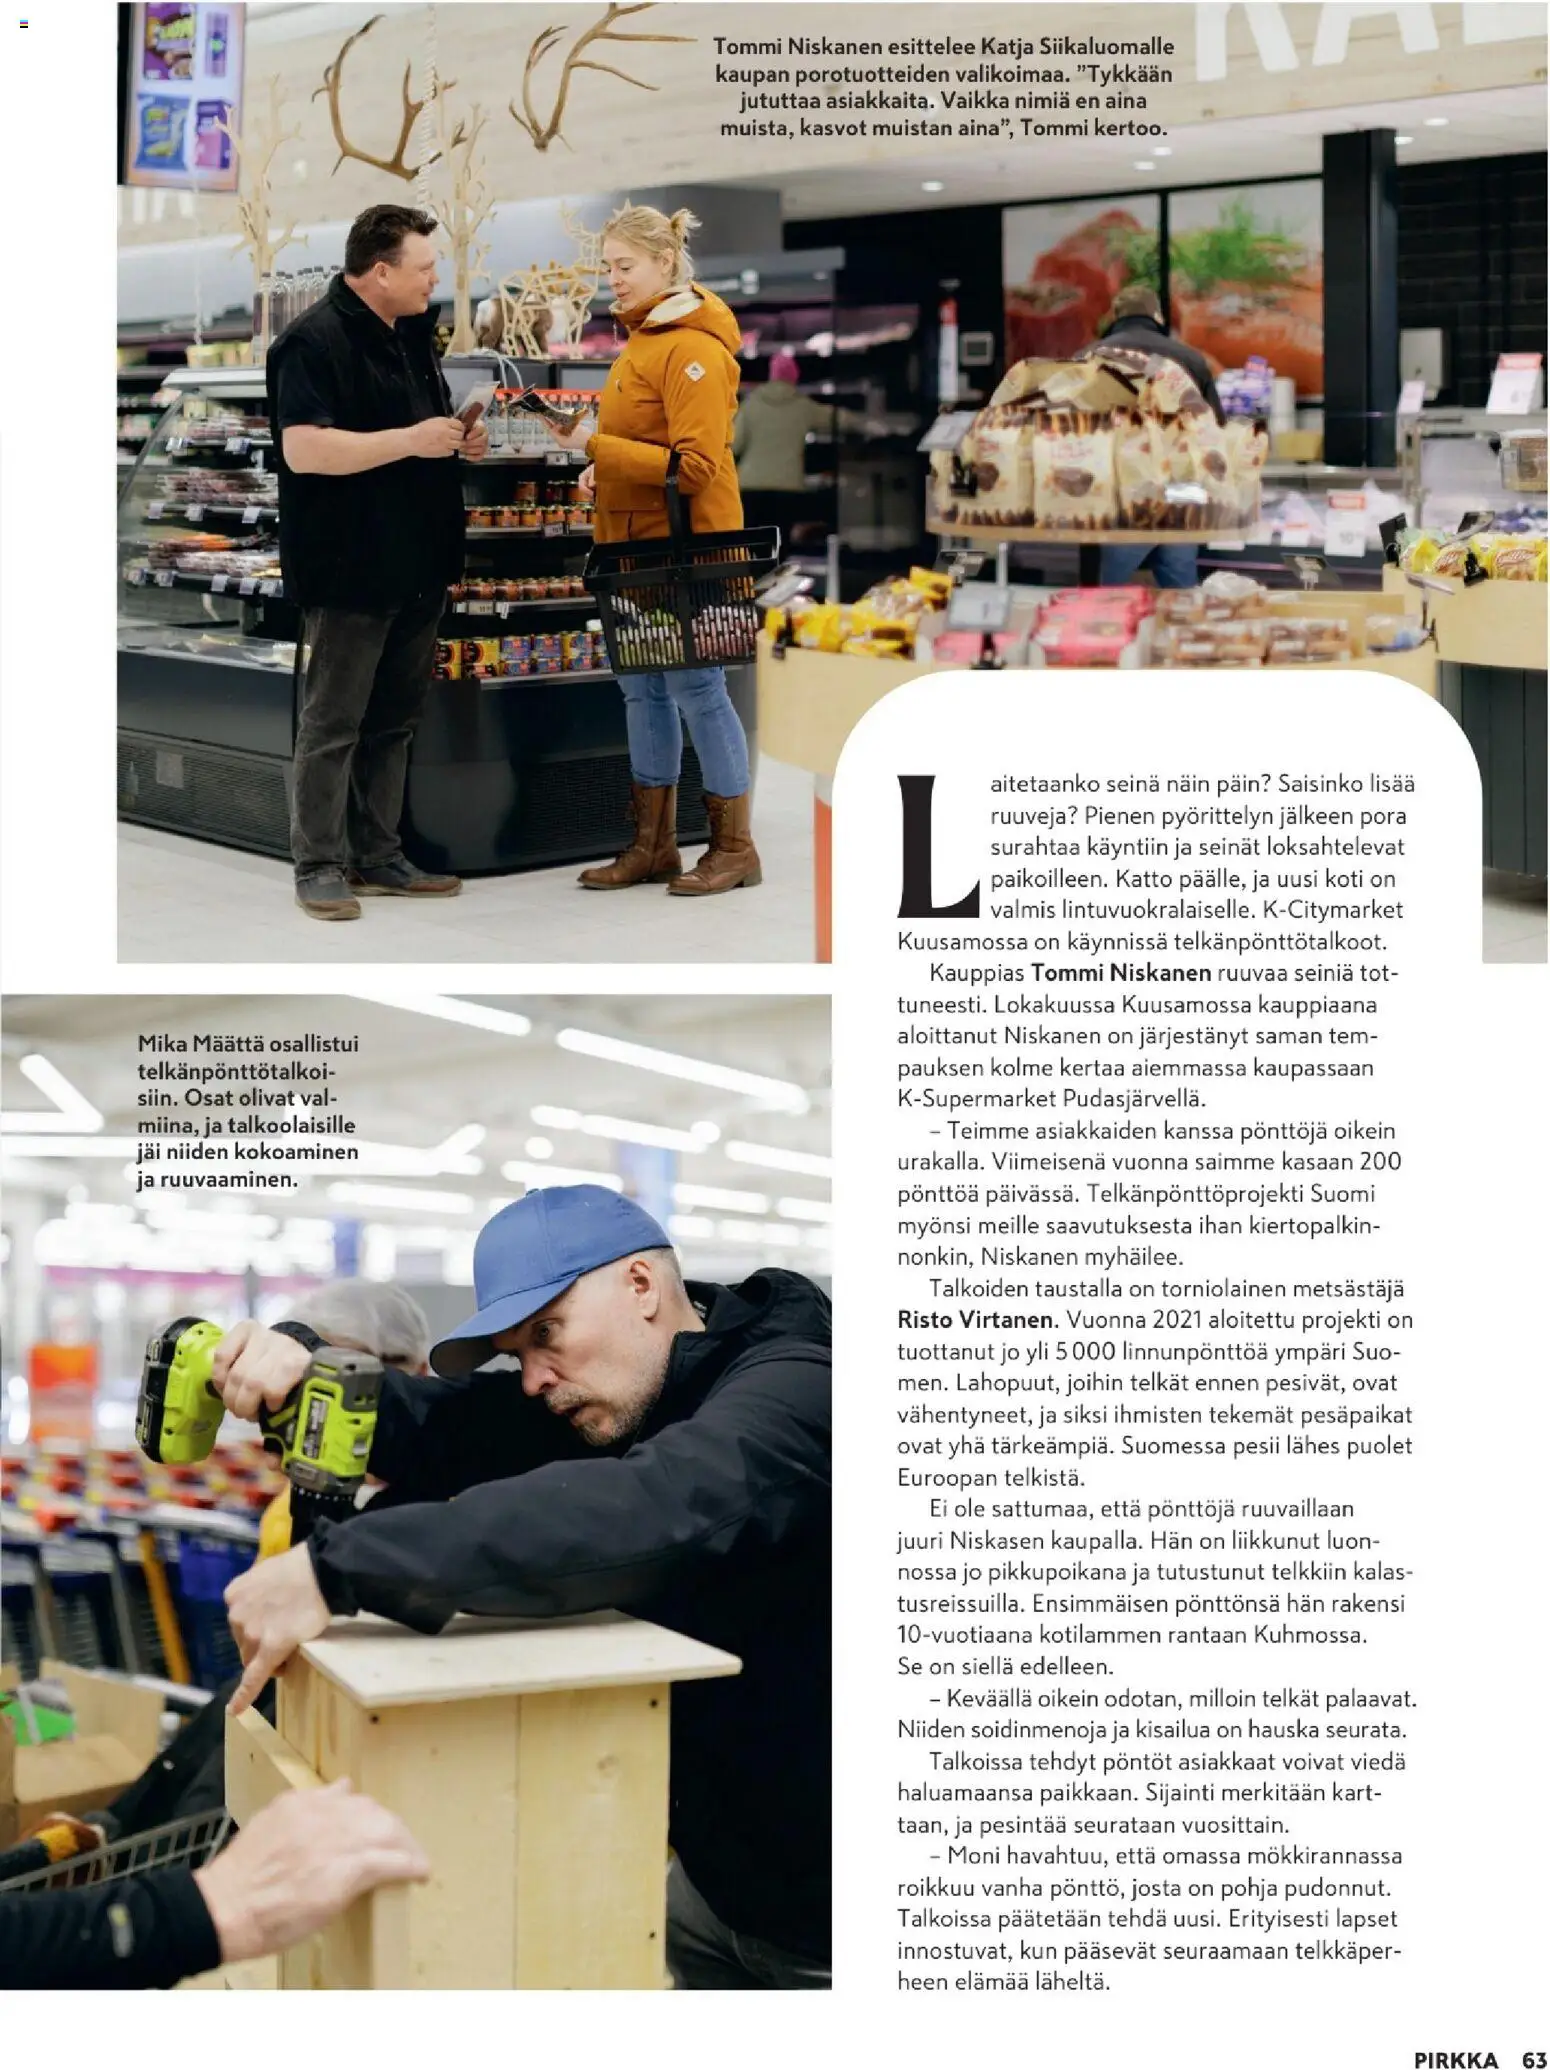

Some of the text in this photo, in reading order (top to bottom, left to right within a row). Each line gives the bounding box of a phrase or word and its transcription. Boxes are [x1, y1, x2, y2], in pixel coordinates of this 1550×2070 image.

[990, 772, 1415, 798] aitetaanko seinä näin päin? Saisinko lisää
[991, 804, 1407, 830] ruuveja? Pienen pyörittelyn jälkeen pora
[897, 775, 981, 918] L
[990, 898, 1404, 924] valmis lintuvuokralaiselle. K-Citymarket
[898, 930, 1387, 956] Kuusamossa on käynnissä telkänpönttötalkoot.
[930, 961, 1399, 987] Kauppias Tommi Niskanen ruuvaa seiniä tot-
[897, 993, 1377, 1019] tuneesti. Lokakuussa Kuusamossa kauppiaana
[897, 1024, 1378, 1050] aloittanut Niskanen on järjestänyt saman tem-
[898, 1087, 1206, 1113] K-Supermarket Pudasjärvellä.
[898, 1182, 1375, 1208] pönttöä päivässä. Telkänpönttöprojekti Suomi
[898, 1214, 1381, 1240] myönsi meille saavutuksesta ihan kiertopalkin-
[898, 1245, 1184, 1271] nonkin, Niskanen myhäilee.
[929, 1276, 1404, 1304] Talkoiden taustalla on torniolainen metsästäjä
[898, 1308, 1413, 1334] Risto Virtanen. Vuonna 2021 aloitettu projekti on
[898, 1370, 1398, 1397] men. Lahopuut, joihin telkät ennen pesivät, ovat
[898, 1466, 1085, 1492] Euroopan telkistä.
[895, 1529, 1380, 1555] juuri Niskasen kaupalla. Hän on liikkunut luon-
[896, 1592, 1405, 1618] tusreissuilla. Ensimmäisen pönttönsä hän rakensi
[897, 1622, 1367, 1644] 10-vuotiaana kotilammen rantaan Kuhmossa.
[898, 1655, 1114, 1675] Se on siellä edelleen.
[929, 1750, 1406, 1777] Talkoissa tehdyt pöntöt asiakkaat voivat viedä
[898, 1781, 1382, 1807] haluamaansa paikkaan. Sijainti merkitään kart-
[898, 1939, 1402, 1965] innostuvat, kun pääsevät seuraamaan telkkäper-
[898, 1969, 1110, 1991] heen elämää läheltä.
[1414, 2051, 1548, 2070] PIRKKA 63
